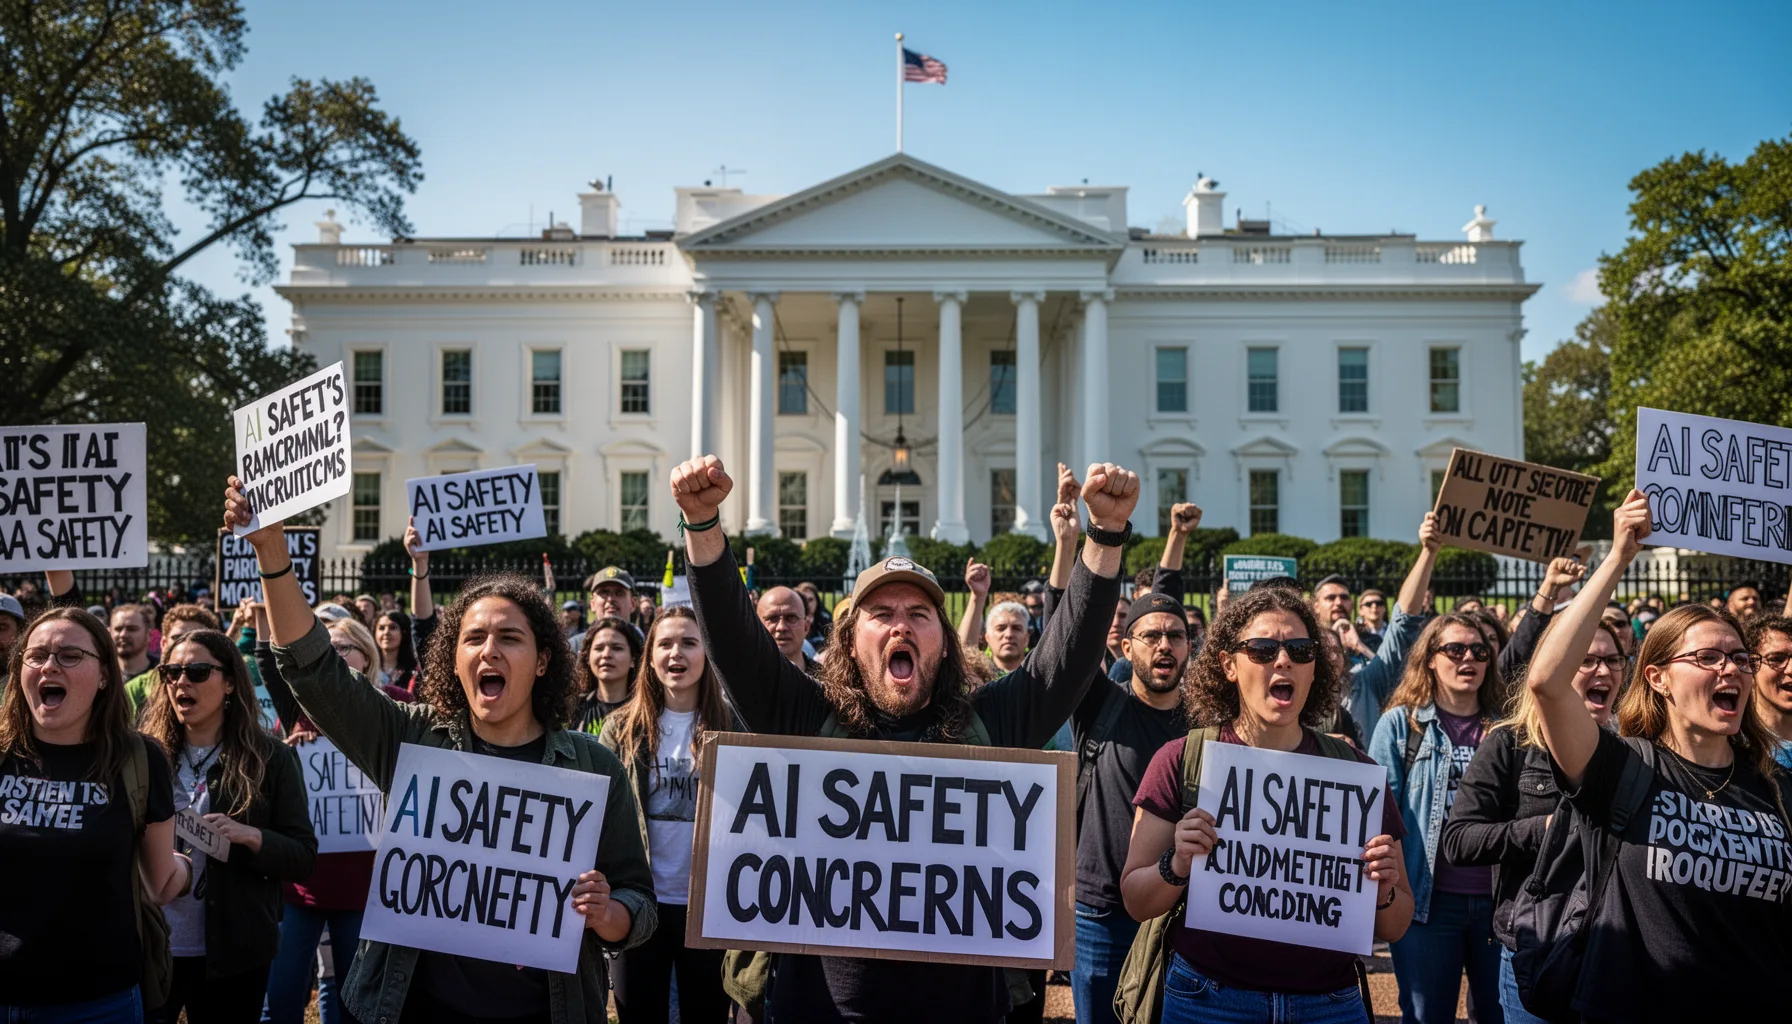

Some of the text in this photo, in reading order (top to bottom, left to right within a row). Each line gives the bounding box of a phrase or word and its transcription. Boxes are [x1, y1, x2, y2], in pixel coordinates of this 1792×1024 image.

[245, 374, 344, 448] AI SAFET'S
[1453, 454, 1484, 483] ALL
[1489, 462, 1527, 489] UTT
[1647, 423, 1691, 476] AI
[413, 472, 533, 517] AI SAFETY
[426, 507, 525, 542] AI SAFETY
[1483, 487, 1537, 519] NOTE
[390, 774, 593, 863] AI SAFETY
[730, 762, 1044, 851] AI SAFETY
[1215, 766, 1253, 832] AI
[1261, 773, 1380, 848] SAFETY
[380, 847, 576, 939] GORCNEFTY
[726, 852, 1043, 941] CONCRERNS
